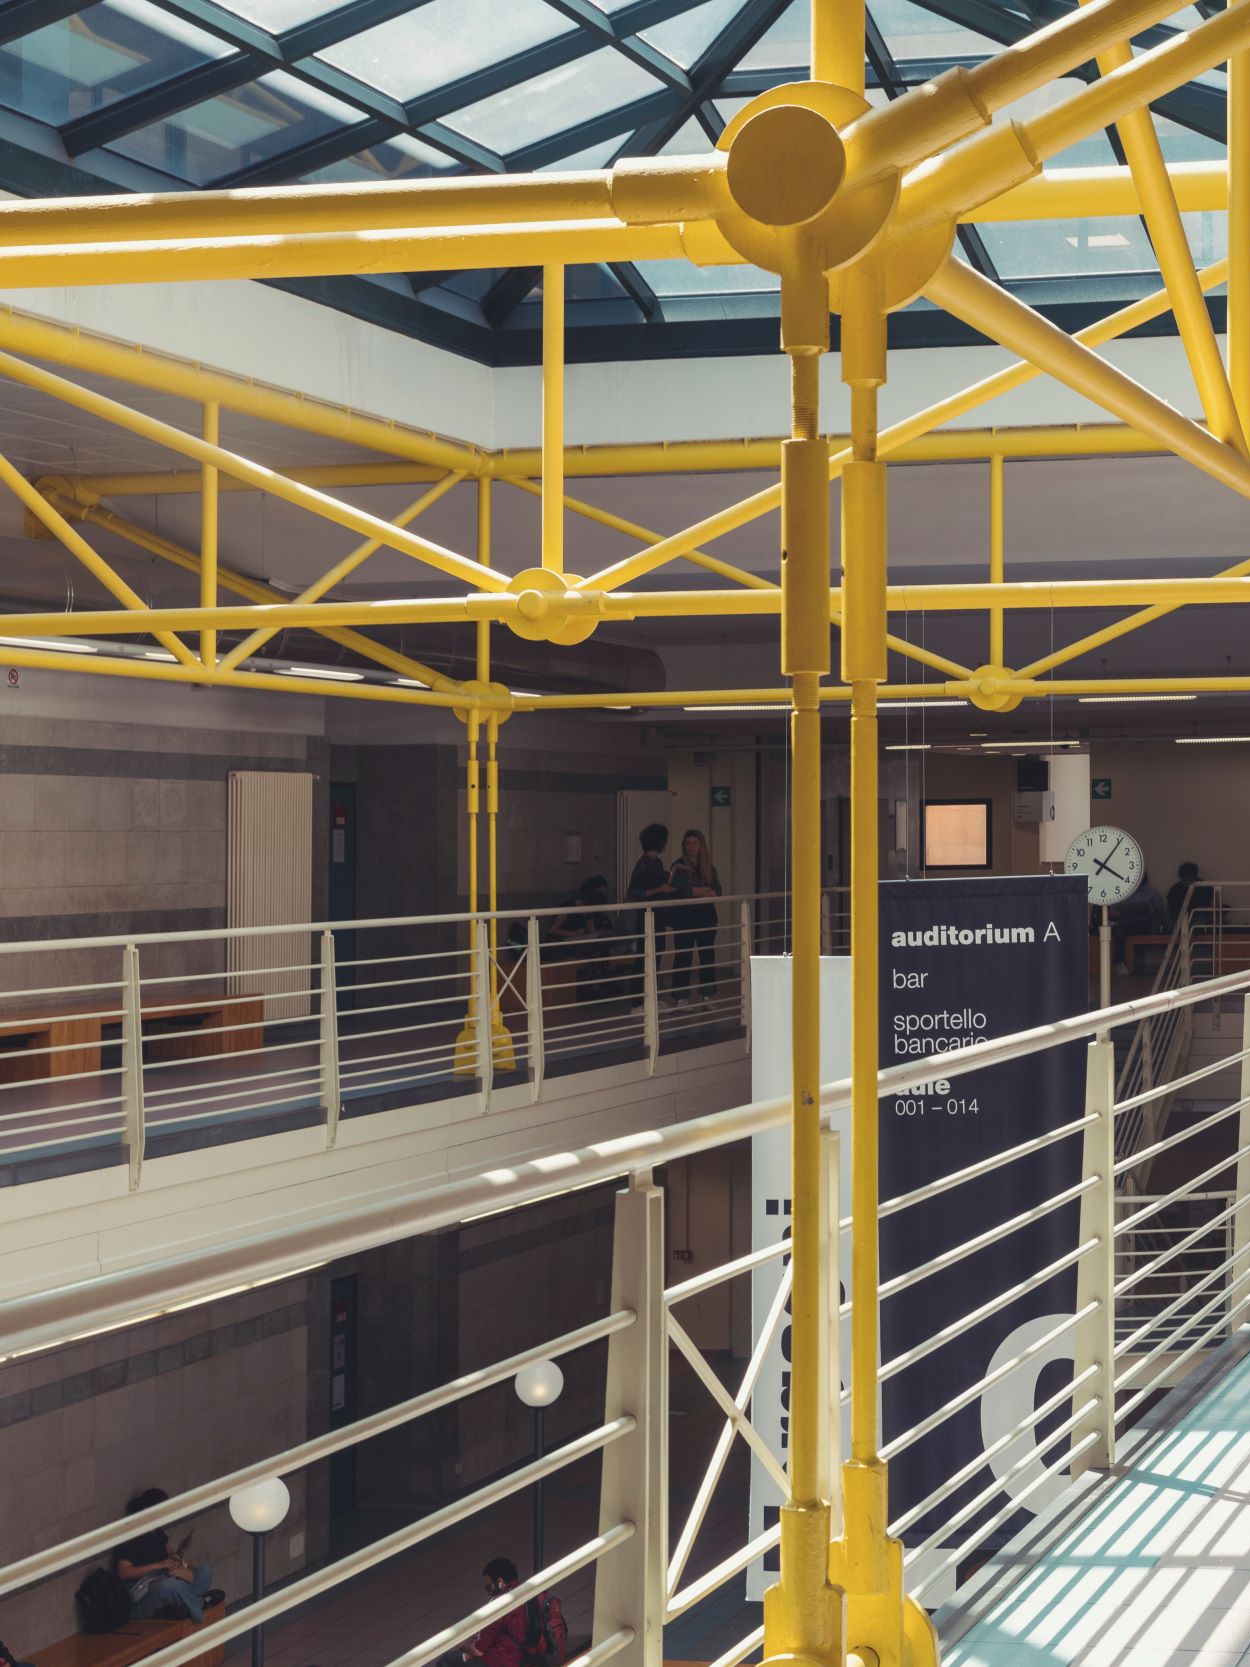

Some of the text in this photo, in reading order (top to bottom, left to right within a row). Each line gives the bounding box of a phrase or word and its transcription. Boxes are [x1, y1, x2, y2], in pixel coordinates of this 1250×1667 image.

[1086, 838, 1093, 846] 11
[1099, 834, 1107, 843] 12
[1076, 849, 1085, 857] 10
[1125, 848, 1131, 856] 2
[1072, 862, 1078, 871] 9
[1129, 861, 1135, 870] 3
[1088, 887, 1093, 895] 7
[1100, 889, 1107, 898] 6
[1115, 886, 1121, 895] 5
[891, 921, 1061, 947] auditorium A
[892, 968, 928, 989] bar
[893, 1008, 987, 1035] sportello
[895, 1100, 924, 1115] 001
[947, 1098, 979, 1115] 014
